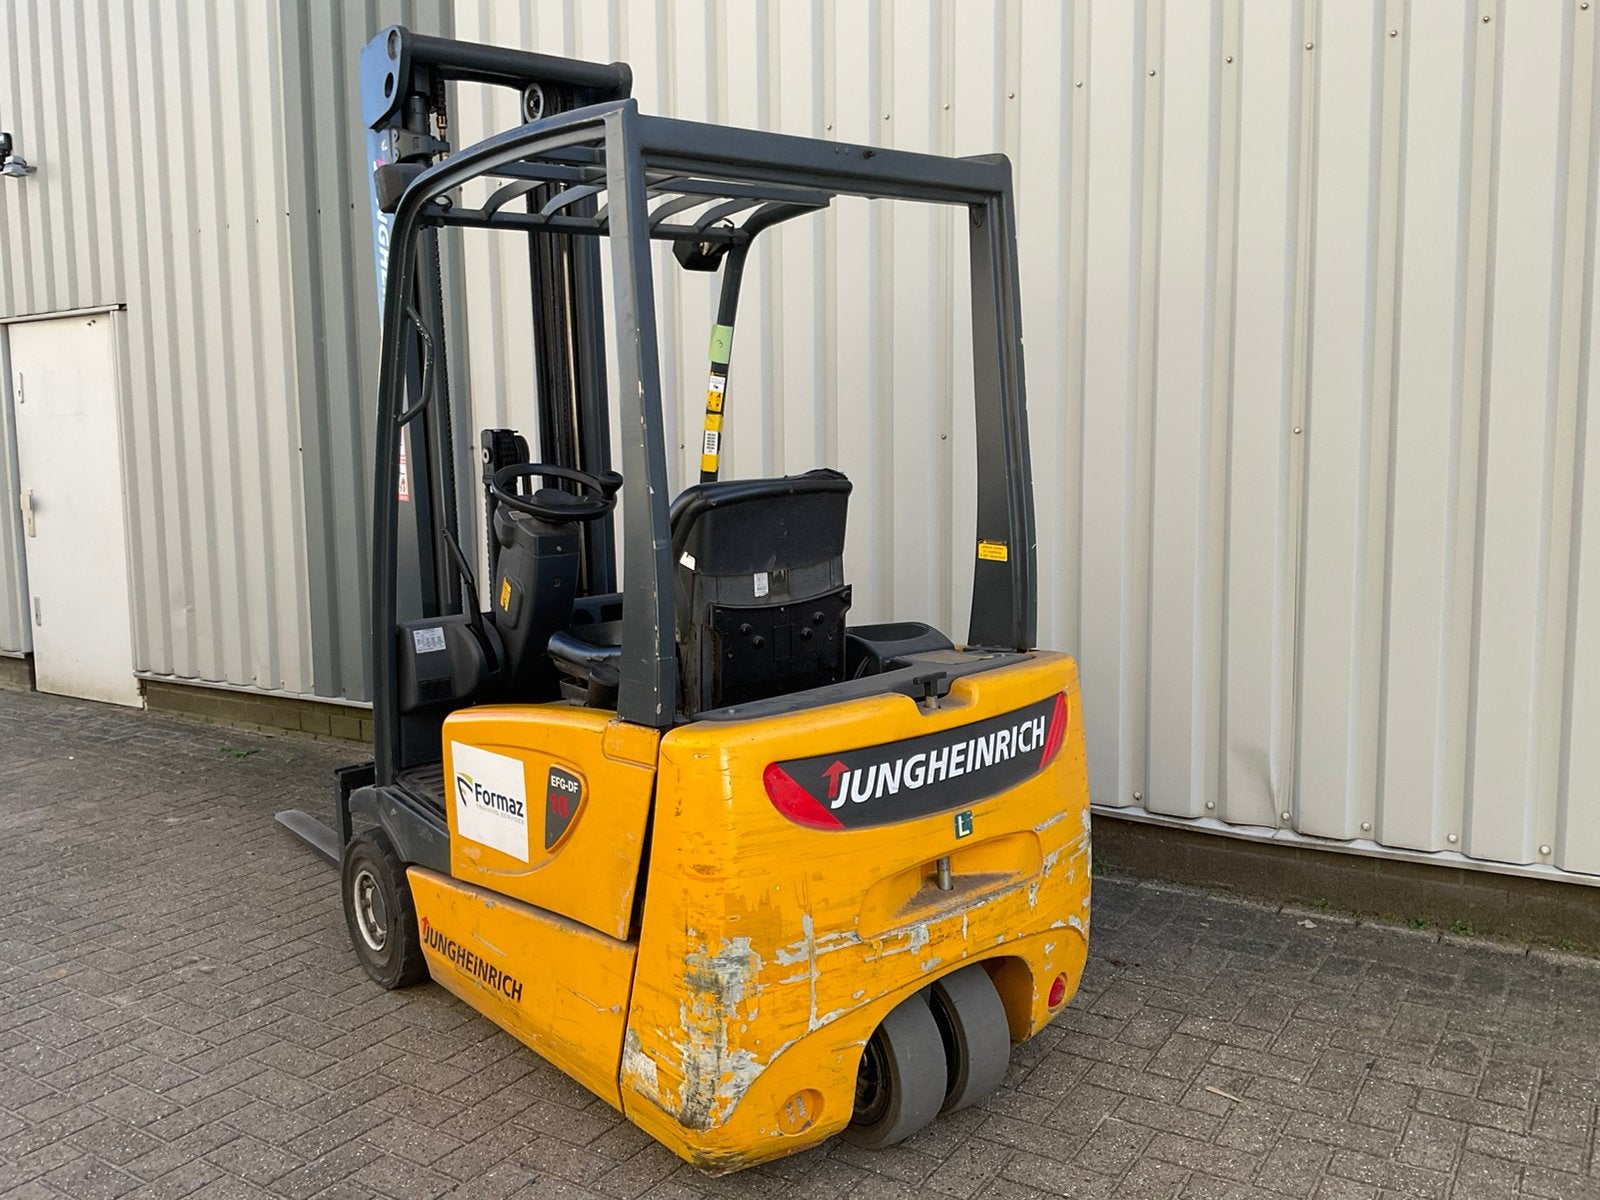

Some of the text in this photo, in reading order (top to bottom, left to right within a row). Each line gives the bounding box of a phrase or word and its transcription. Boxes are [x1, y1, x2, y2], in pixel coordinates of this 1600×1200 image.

[550, 775, 579, 794] EFG-DF
[830, 715, 1046, 809] JUNGHEINRICH
[474, 782, 524, 818] Formaz
[424, 926, 523, 1003] JUNGHEINRICH
